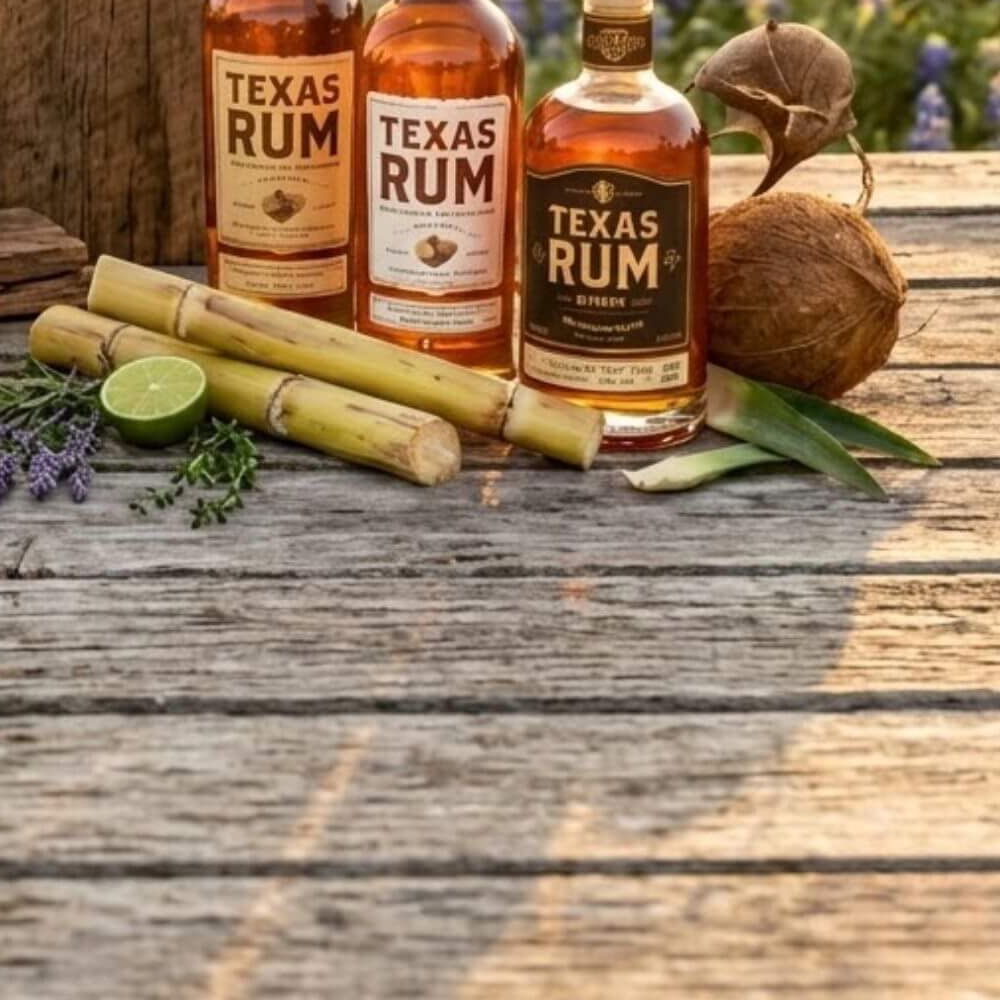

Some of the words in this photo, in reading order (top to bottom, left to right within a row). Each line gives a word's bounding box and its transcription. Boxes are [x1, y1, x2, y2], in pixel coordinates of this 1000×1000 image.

[226, 72, 341, 106] TEXAS
[227, 108, 340, 159] RUM
[379, 115, 496, 151] TEXAS
[380, 152, 495, 205] RUM
[548, 204, 659, 240] TEXAS
[548, 238, 659, 290] RUM
